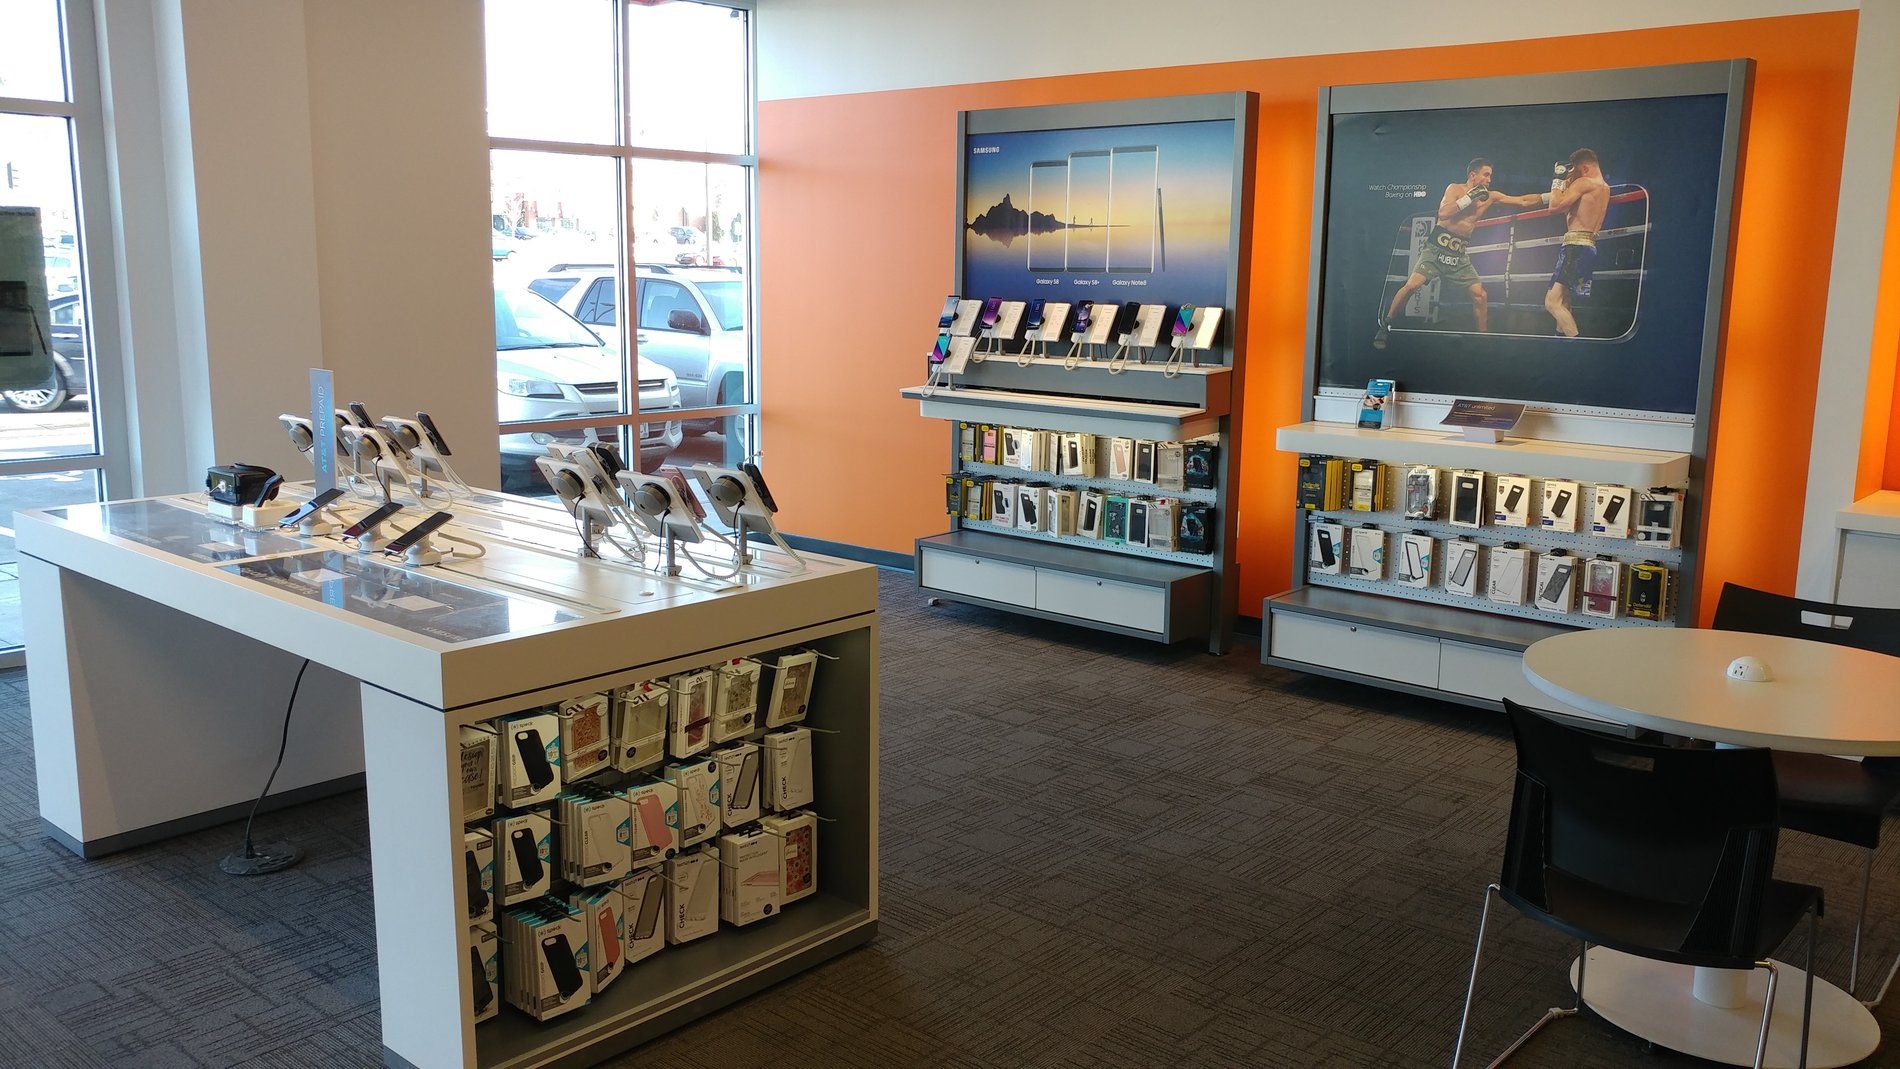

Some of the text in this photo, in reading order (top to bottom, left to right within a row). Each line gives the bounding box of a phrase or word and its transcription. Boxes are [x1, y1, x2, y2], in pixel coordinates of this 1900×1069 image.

[973, 146, 1000, 154] SAMSUNG
[1387, 183, 1427, 191] Championship
[1385, 191, 1404, 199] Boxing
[1413, 190, 1427, 198] HBO
[1437, 232, 1469, 254] GGG
[1438, 254, 1460, 266] HUBLOT
[1036, 278, 1053, 286] Galaxy
[1112, 279, 1130, 287] Galaxy
[317, 385, 326, 436] PREPAID
[1471, 403, 1496, 411] unlimited
[641, 788, 654, 796] speck
[591, 803, 605, 811] speck
[516, 818, 528, 826] speck
[547, 924, 561, 934] speck
